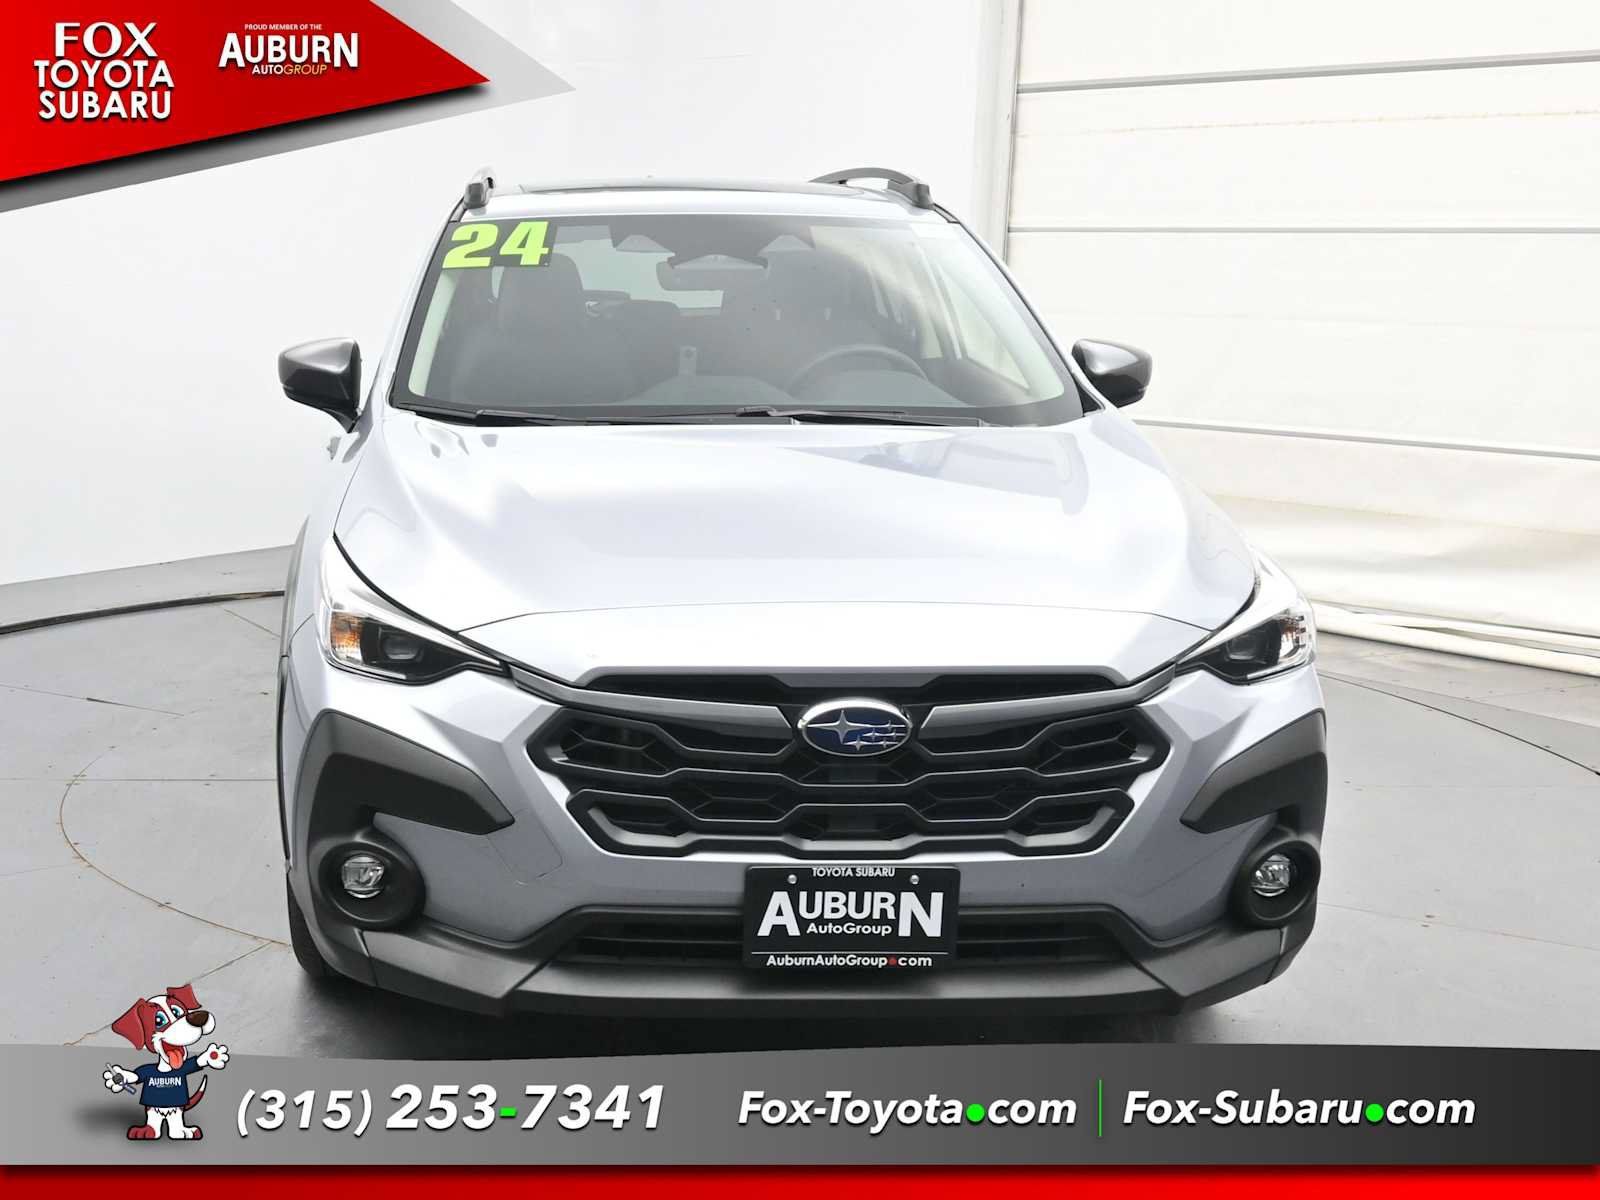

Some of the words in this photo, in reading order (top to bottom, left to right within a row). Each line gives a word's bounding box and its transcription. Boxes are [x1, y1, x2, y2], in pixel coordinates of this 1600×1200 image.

[442, 221, 549, 269] 24
[812, 867, 853, 878] TOYOTA
[855, 867, 895, 878] SUBARU
[757, 891, 944, 938] AUBURN
[806, 922, 892, 936] AutoGroup
